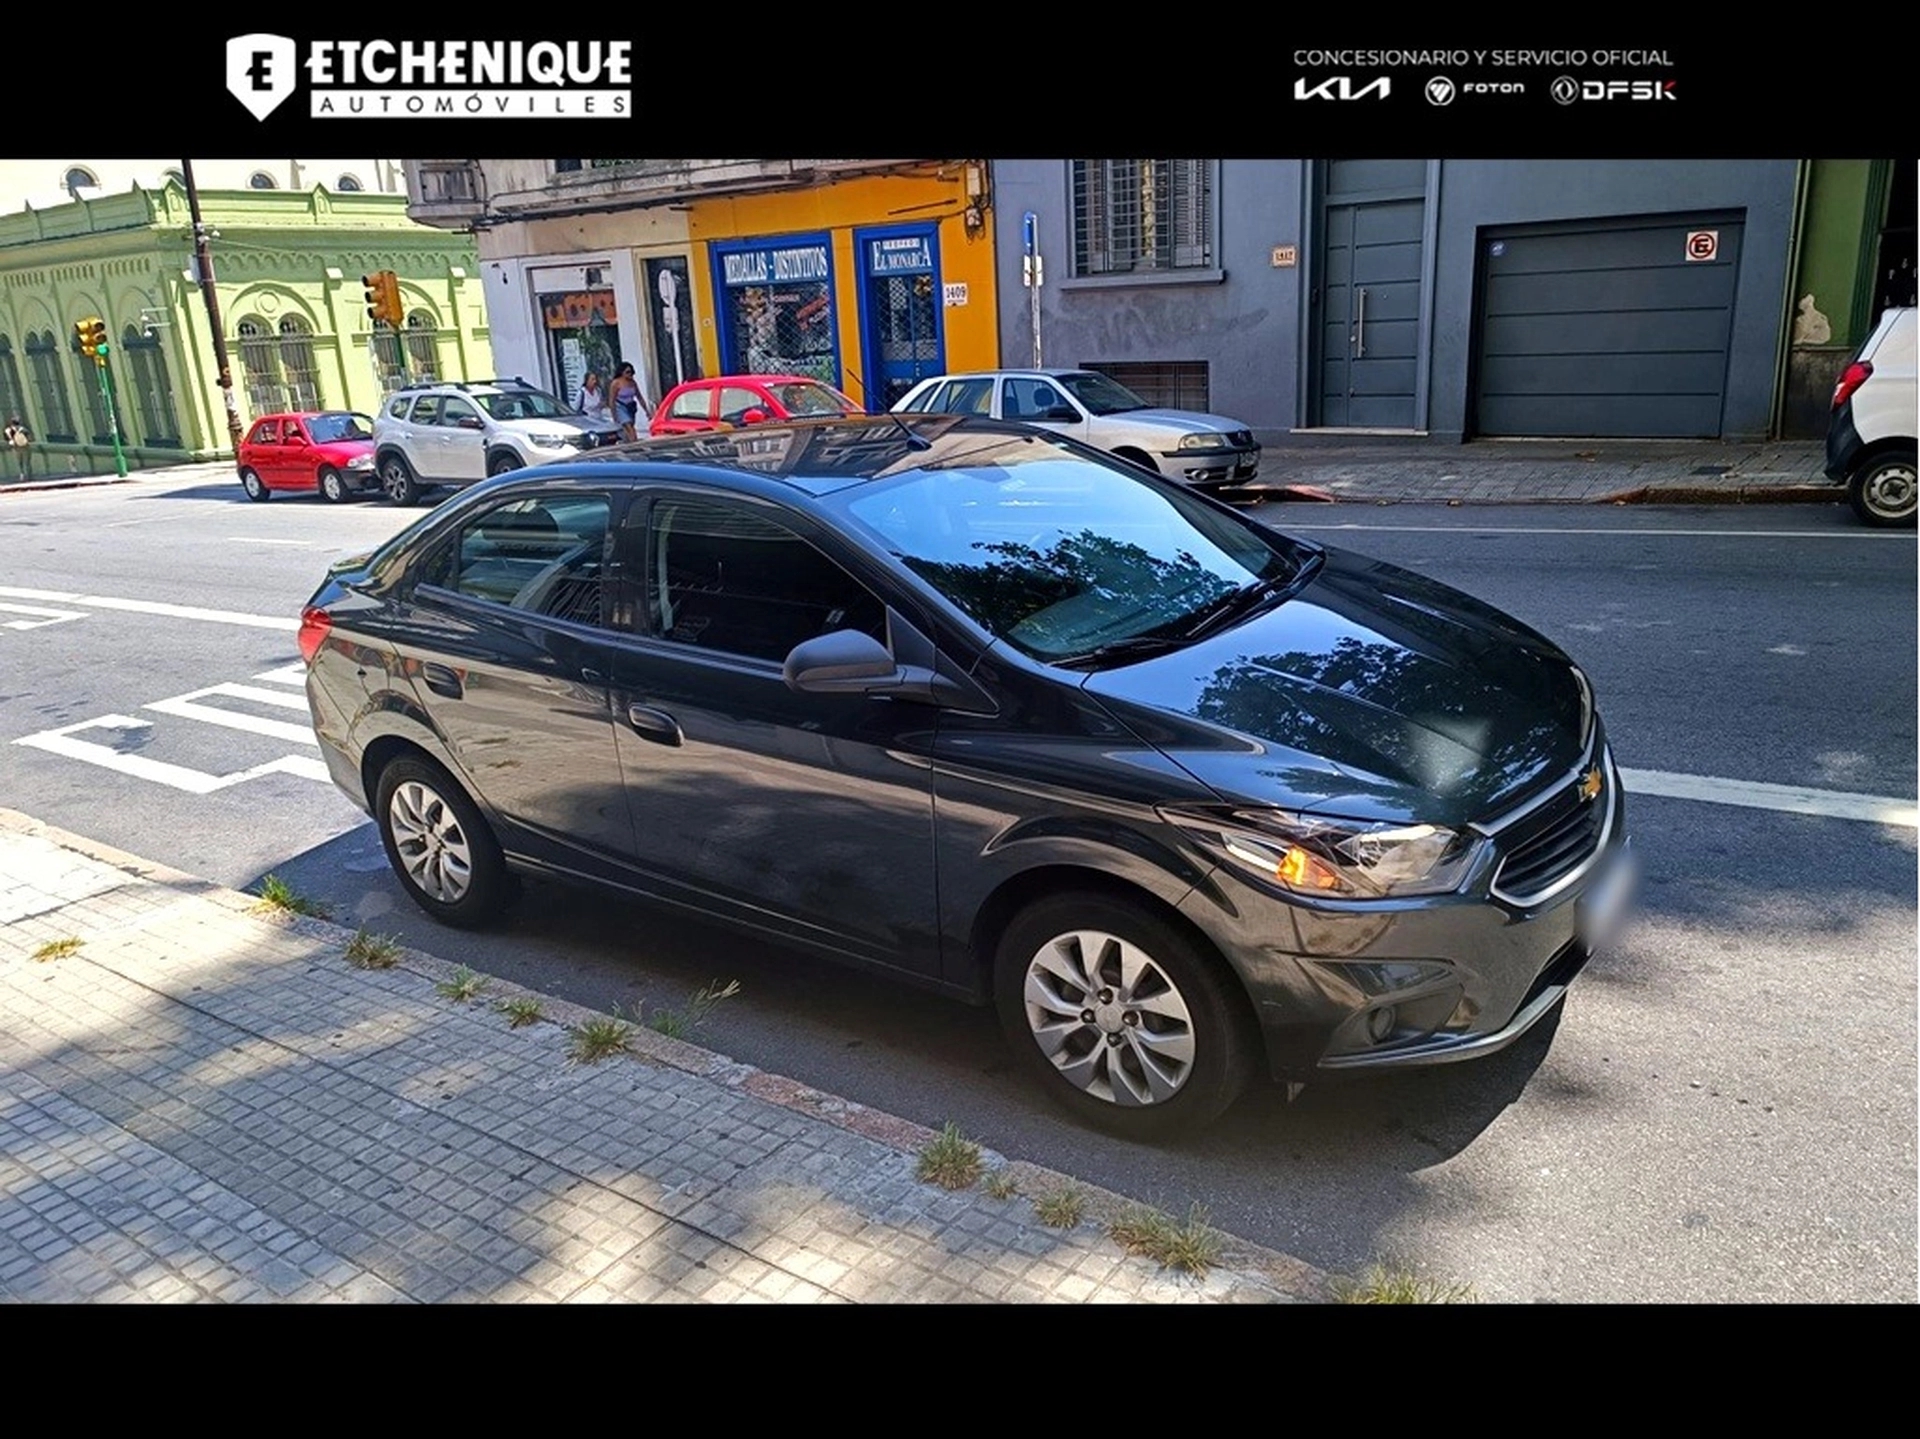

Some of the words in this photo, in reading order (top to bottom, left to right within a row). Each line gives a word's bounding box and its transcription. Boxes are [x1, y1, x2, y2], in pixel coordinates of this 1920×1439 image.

[723, 251, 767, 284] MEDALLAS
[772, 246, 828, 280] DISTINTIVOS
[888, 238, 932, 270] MONARCA
[945, 285, 966, 298] 1409
